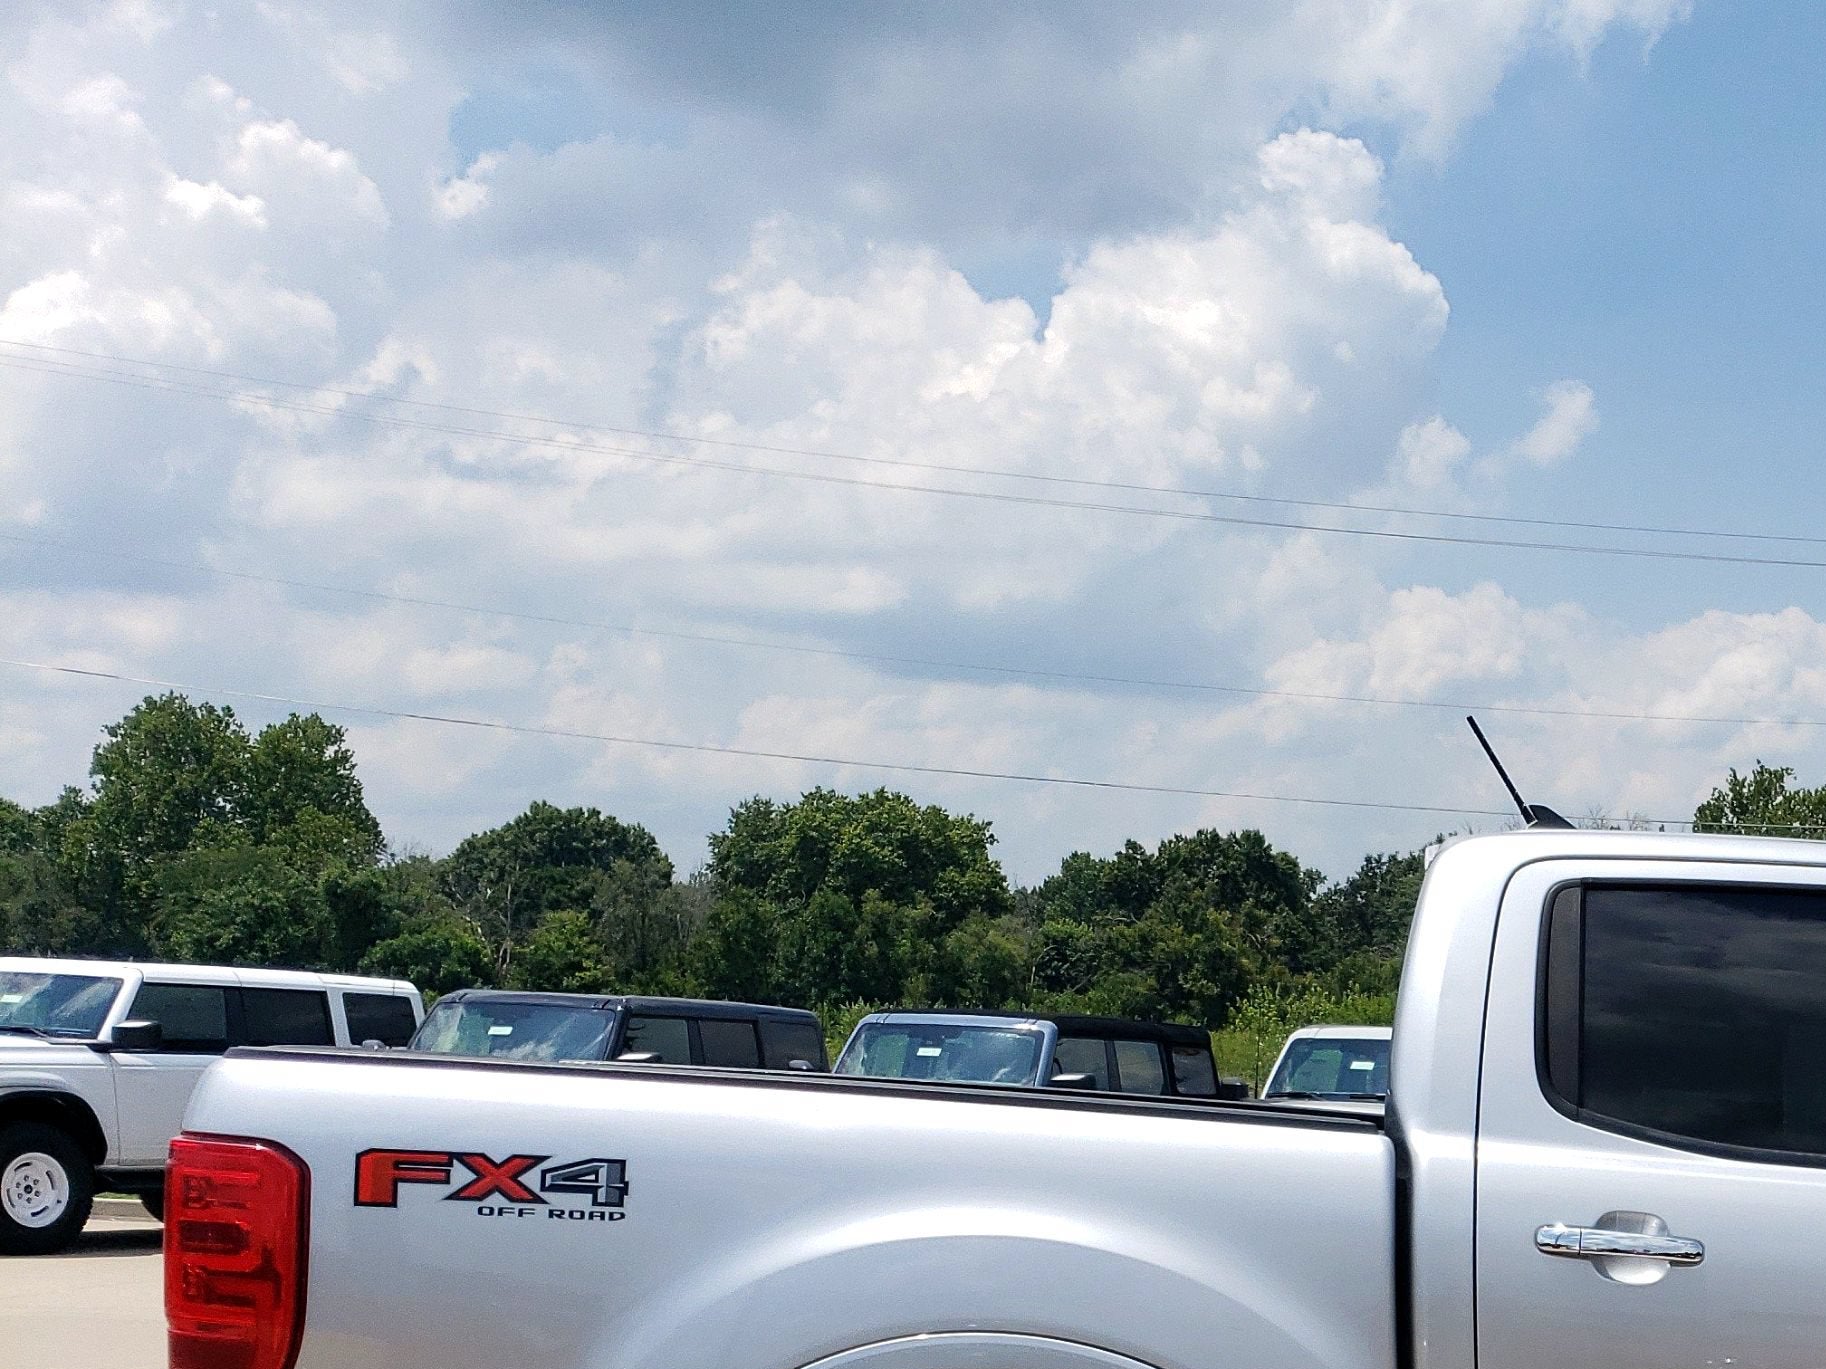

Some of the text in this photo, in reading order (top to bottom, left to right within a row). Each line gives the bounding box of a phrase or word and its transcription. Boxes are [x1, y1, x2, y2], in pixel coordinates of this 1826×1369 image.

[353, 1147, 630, 1209] FX4
[477, 1205, 627, 1222] OFF ROAD
